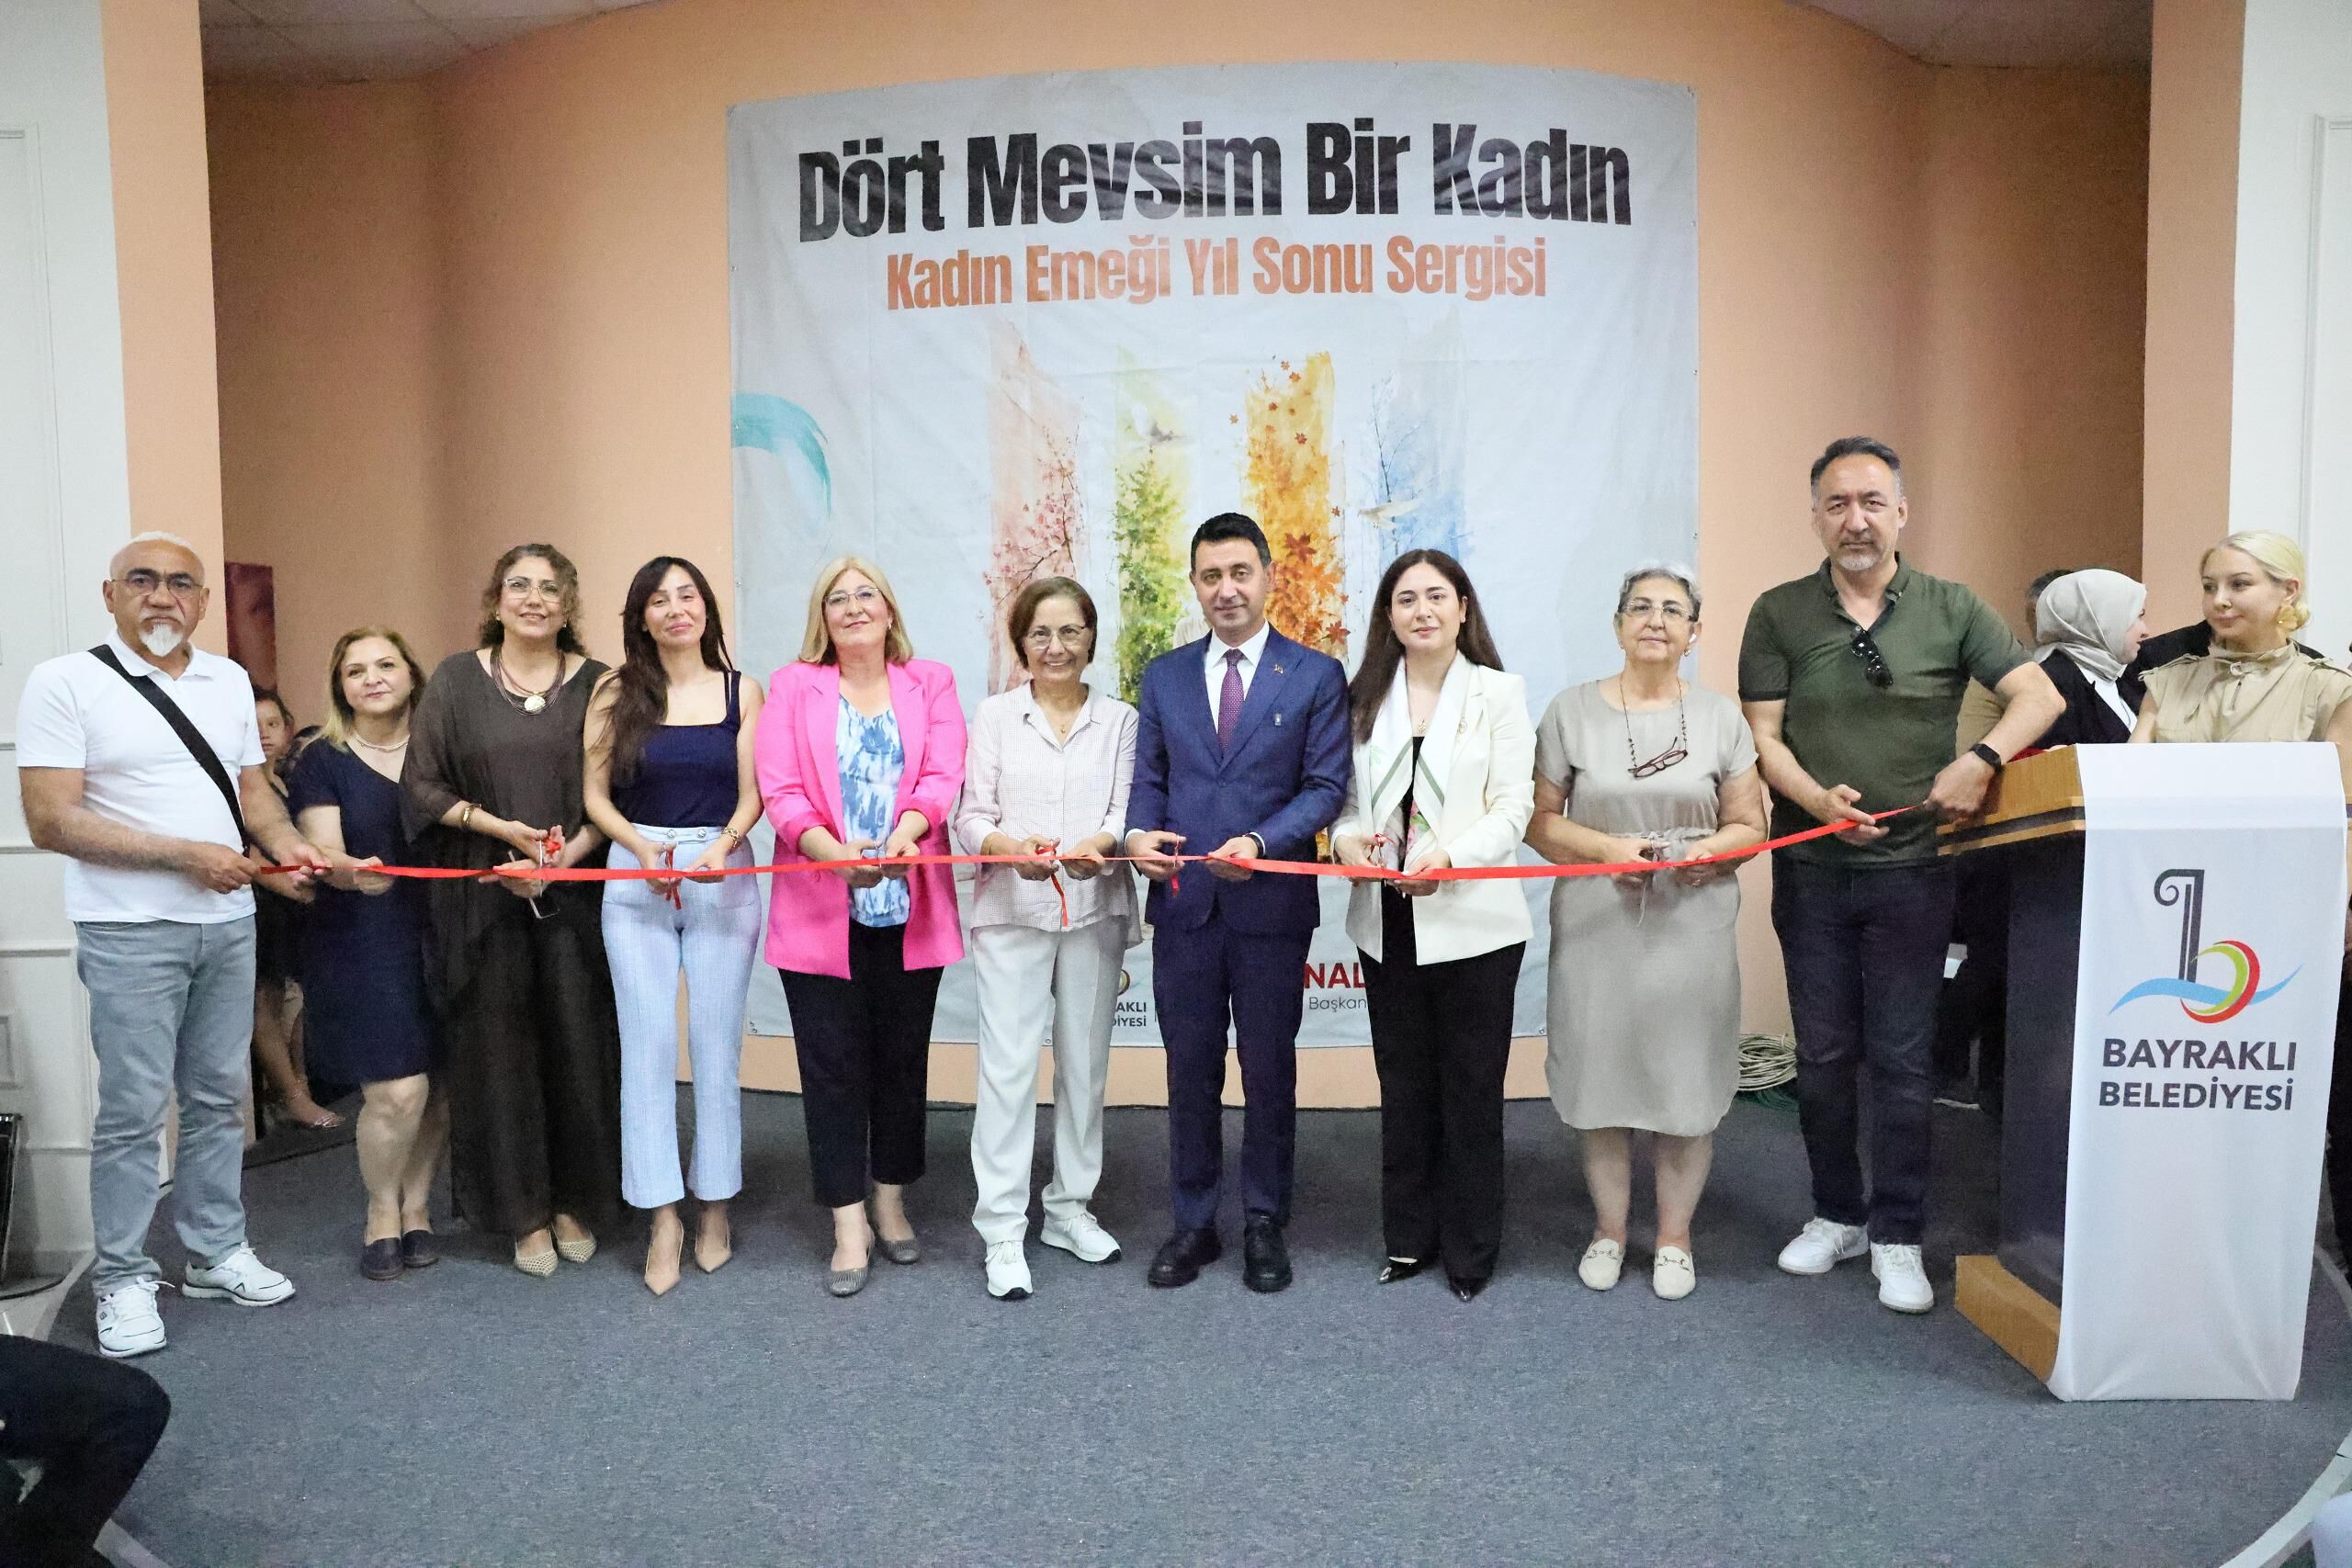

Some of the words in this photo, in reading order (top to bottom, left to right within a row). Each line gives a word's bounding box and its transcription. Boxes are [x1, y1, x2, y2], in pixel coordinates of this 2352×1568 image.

[797, 136, 945, 243] Dört
[967, 120, 1283, 229] Mevsim
[1306, 117, 1411, 215] Bir
[1432, 122, 1632, 226] Kadın
[888, 250, 1012, 310] Kadın
[1026, 235, 1170, 304] Emeği
[1186, 239, 1239, 298] Yıl
[1253, 237, 1373, 297] Sonu
[1387, 235, 1546, 301] Sergisi
[1304, 962, 1367, 989] NAL
[1115, 1001, 1148, 1013] AKLI
[2102, 1038, 2297, 1071] BAYRAKLI
[2098, 1076, 2294, 1111] BELEDİYESİ
